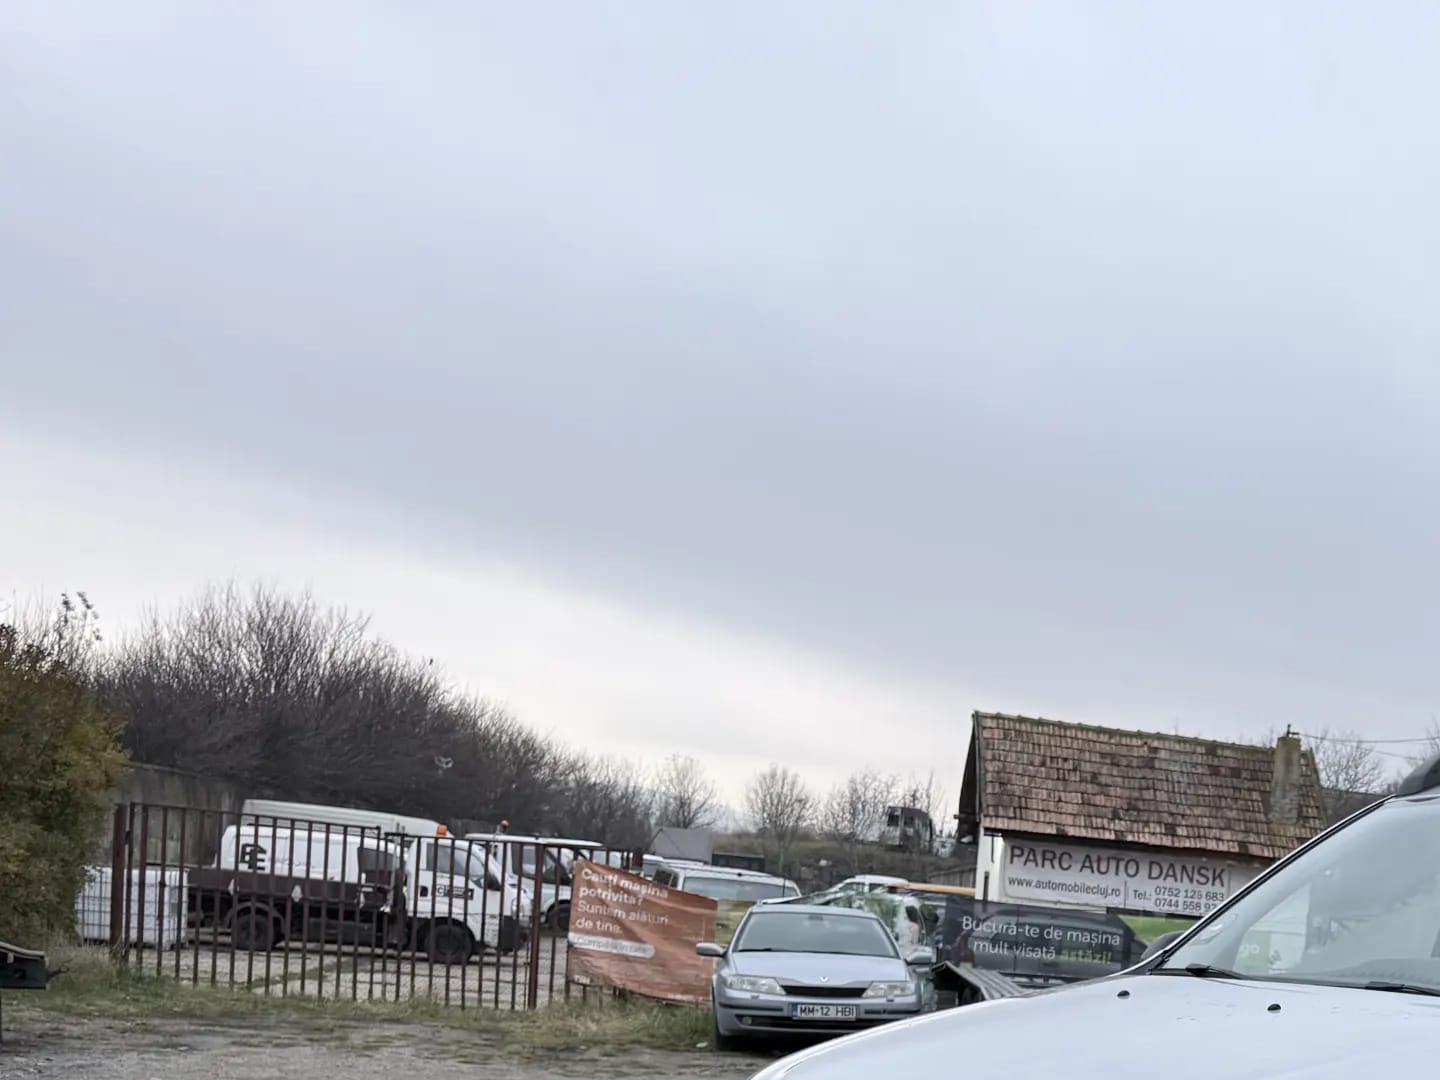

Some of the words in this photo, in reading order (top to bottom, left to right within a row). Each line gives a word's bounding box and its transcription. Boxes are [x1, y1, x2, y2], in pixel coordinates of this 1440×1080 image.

[1009, 845, 1073, 871] PARC
[1079, 853, 1140, 879] AUTO
[1147, 861, 1226, 888] DANSK
[1007, 876, 1121, 899] www.automobilecluj.ro
[1154, 885, 1181, 899] 0752
[1204, 891, 1225, 904] 683
[577, 900, 626, 919] Suntem
[1154, 897, 1180, 909] 0744
[575, 917, 594, 929] de
[961, 915, 1040, 939] Bucură-te
[1043, 925, 1063, 939] de
[1066, 930, 1121, 947] mașina
[973, 940, 1009, 955] mult
[1013, 943, 1056, 960] visată
[1059, 949, 1112, 965] astăzi!
[820, 1006, 831, 1017] 12
